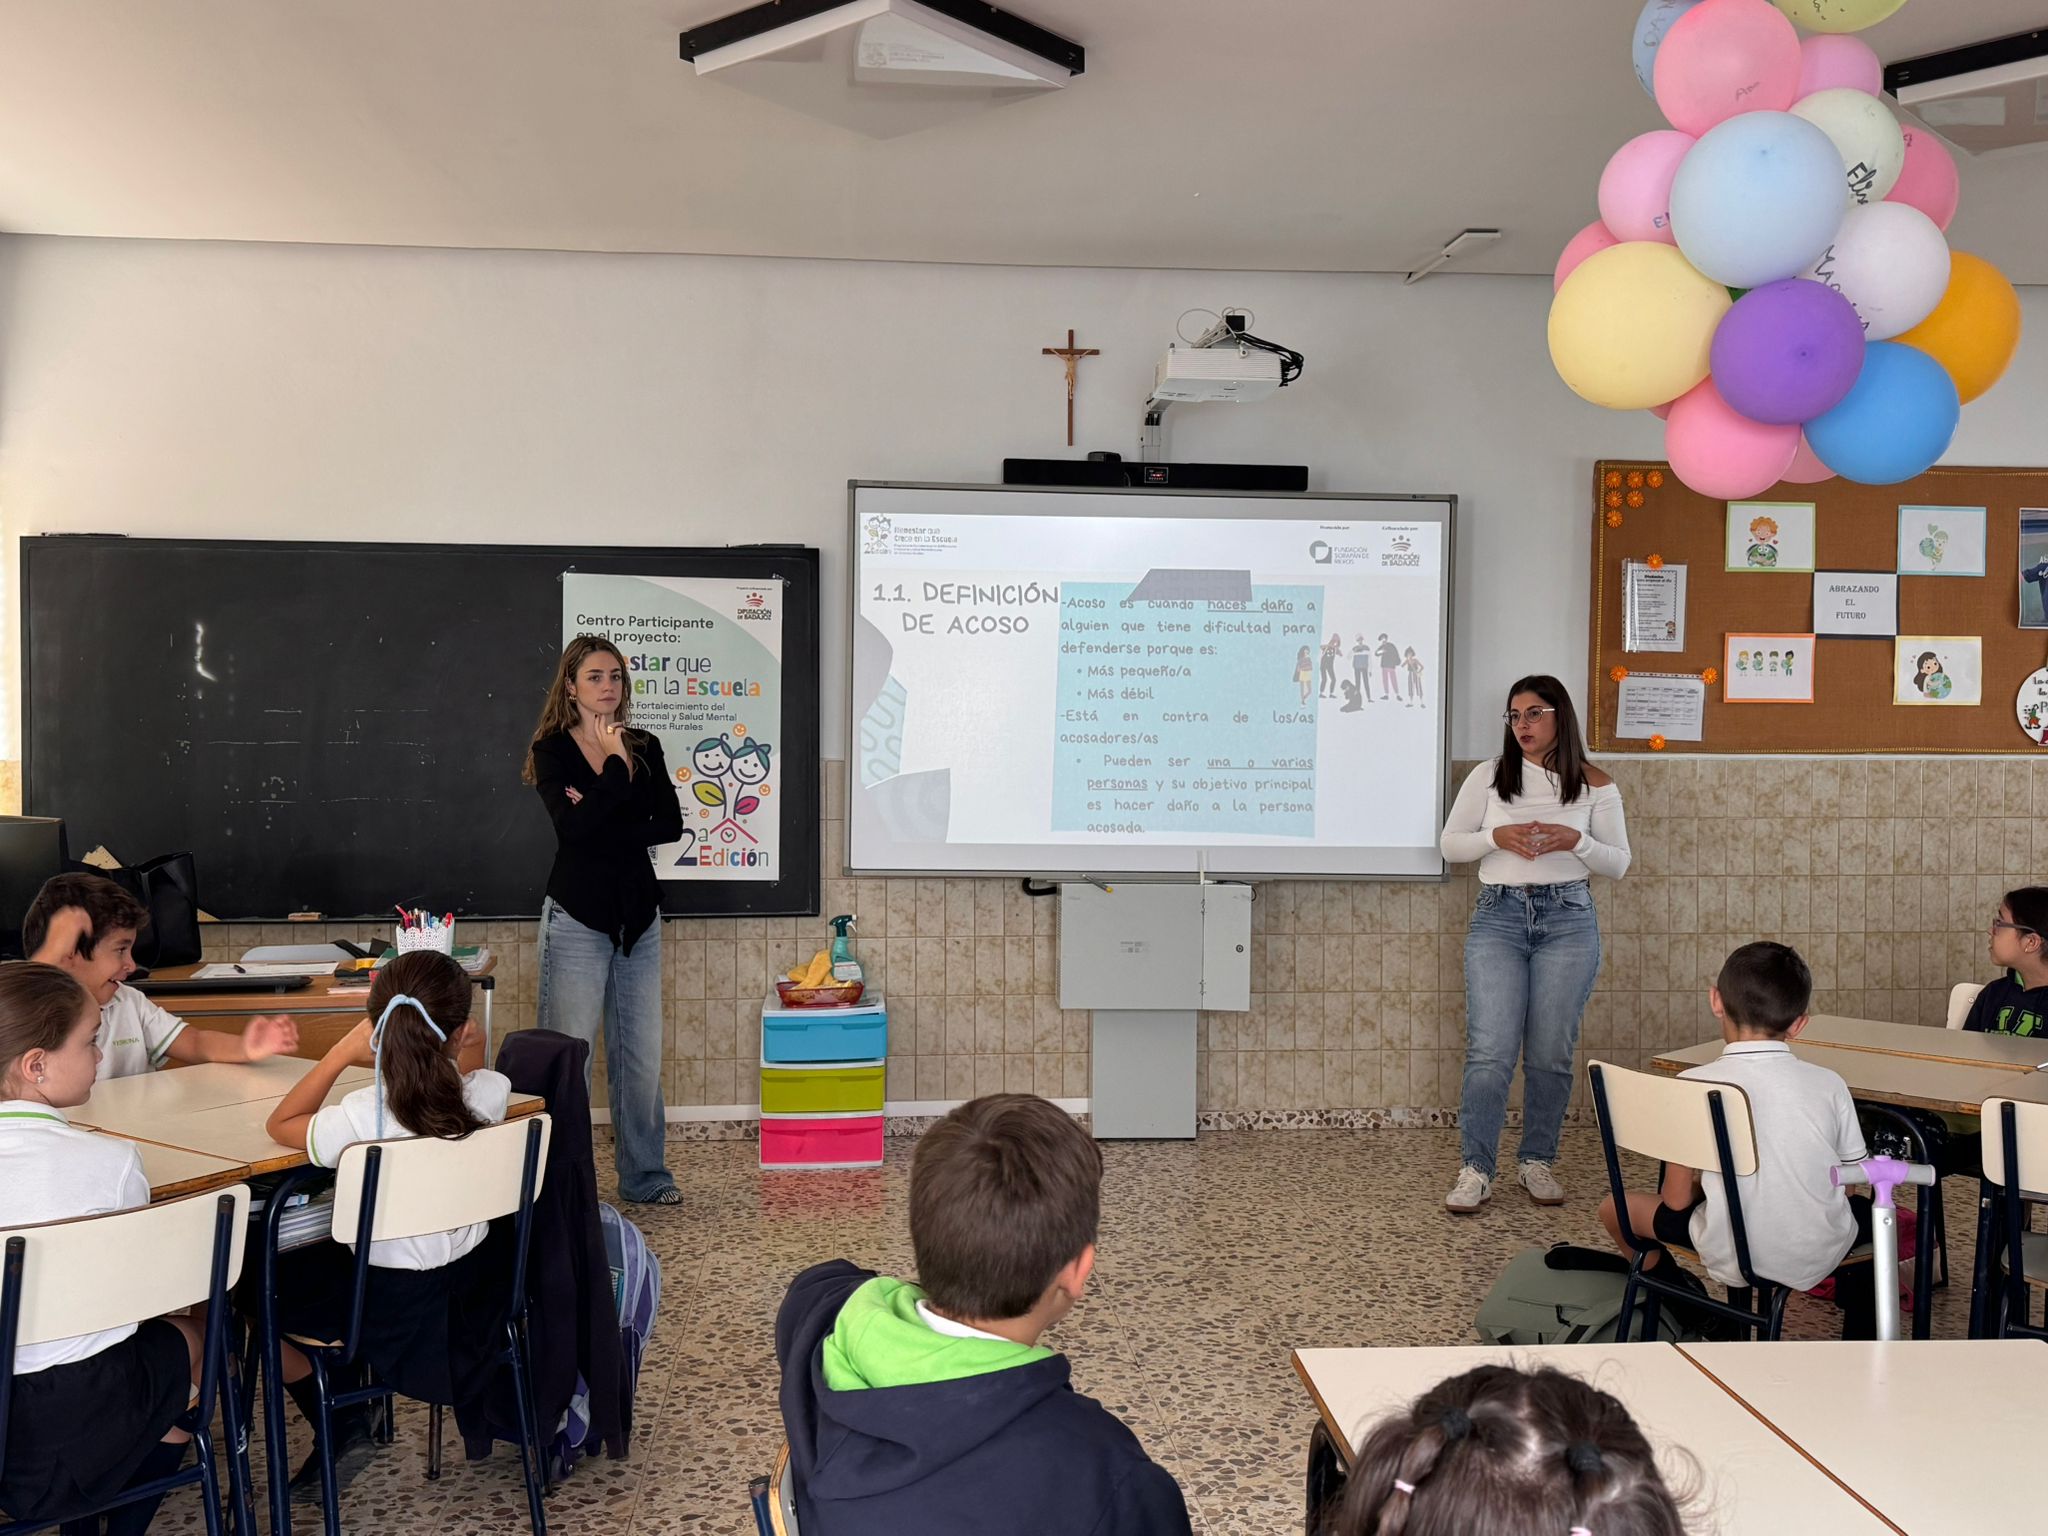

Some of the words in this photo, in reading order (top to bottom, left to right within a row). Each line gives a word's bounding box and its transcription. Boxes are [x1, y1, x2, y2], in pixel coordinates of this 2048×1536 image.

[1382, 552, 1420, 560] DIPUTACIÓN
[873, 584, 911, 602] 1.1.
[923, 582, 1058, 606] DEFINICIÓN
[1828, 584, 1880, 593] ABRAZANDO
[1120, 600, 1134, 608] es
[1148, 600, 1194, 610] cuando
[1208, 600, 1247, 610] haces
[1260, 598, 1294, 611] daño
[1306, 602, 1316, 611] a
[576, 614, 625, 626] Centro
[628, 616, 714, 630] Participante
[902, 612, 934, 634] DE
[947, 615, 1030, 634] ACOSO
[1836, 612, 1866, 620] FUTURO
[1061, 618, 1109, 633] alguien
[1121, 622, 1145, 634] que
[1157, 621, 1191, 632] tiene
[1204, 620, 1271, 634] dificultad
[1282, 624, 1316, 636] para
[598, 630, 610, 641] el
[614, 632, 680, 644] proyecto:
[1060, 641, 1140, 654] defenderse
[1147, 644, 1194, 656] porque
[1200, 645, 1217, 655] es:
[676, 656, 712, 674] que
[1088, 665, 1114, 678] Más
[1120, 665, 1192, 678] pequeño/a
[634, 679, 657, 695] en
[664, 676, 680, 695] la
[686, 678, 761, 698] Escuela
[1088, 688, 1114, 700] Más
[1120, 686, 1154, 700] débil
[636, 702, 709, 711] Fortalecimiento
[711, 704, 726, 712] del
[672, 714, 678, 722] y
[679, 712, 704, 721] Salud
[706, 713, 738, 722] Mental
[1122, 712, 1139, 721] en
[1162, 711, 1208, 722] contra
[1232, 710, 1249, 724] de
[1272, 710, 1314, 724] los/as
[669, 722, 704, 732] Rurales
[1060, 732, 1159, 744] acosadores/as
[1104, 754, 1152, 768] Pueden
[1168, 756, 1191, 768] ser
[1207, 758, 1231, 768] una
[1248, 759, 1254, 768] o
[1272, 758, 1314, 769] varias
[1087, 778, 1148, 791] personas
[1156, 780, 1164, 792] y
[1172, 780, 1186, 790] su
[1192, 777, 1248, 792] objetivo
[1254, 778, 1313, 792] principal
[1087, 800, 1102, 810] es
[1114, 798, 1154, 810] hacer
[1167, 798, 1199, 812] daño
[1212, 802, 1220, 812] a
[1232, 798, 1248, 812] la
[1260, 802, 1314, 814] persona
[1087, 822, 1145, 834] acosada.
[700, 845, 768, 867] Edición
